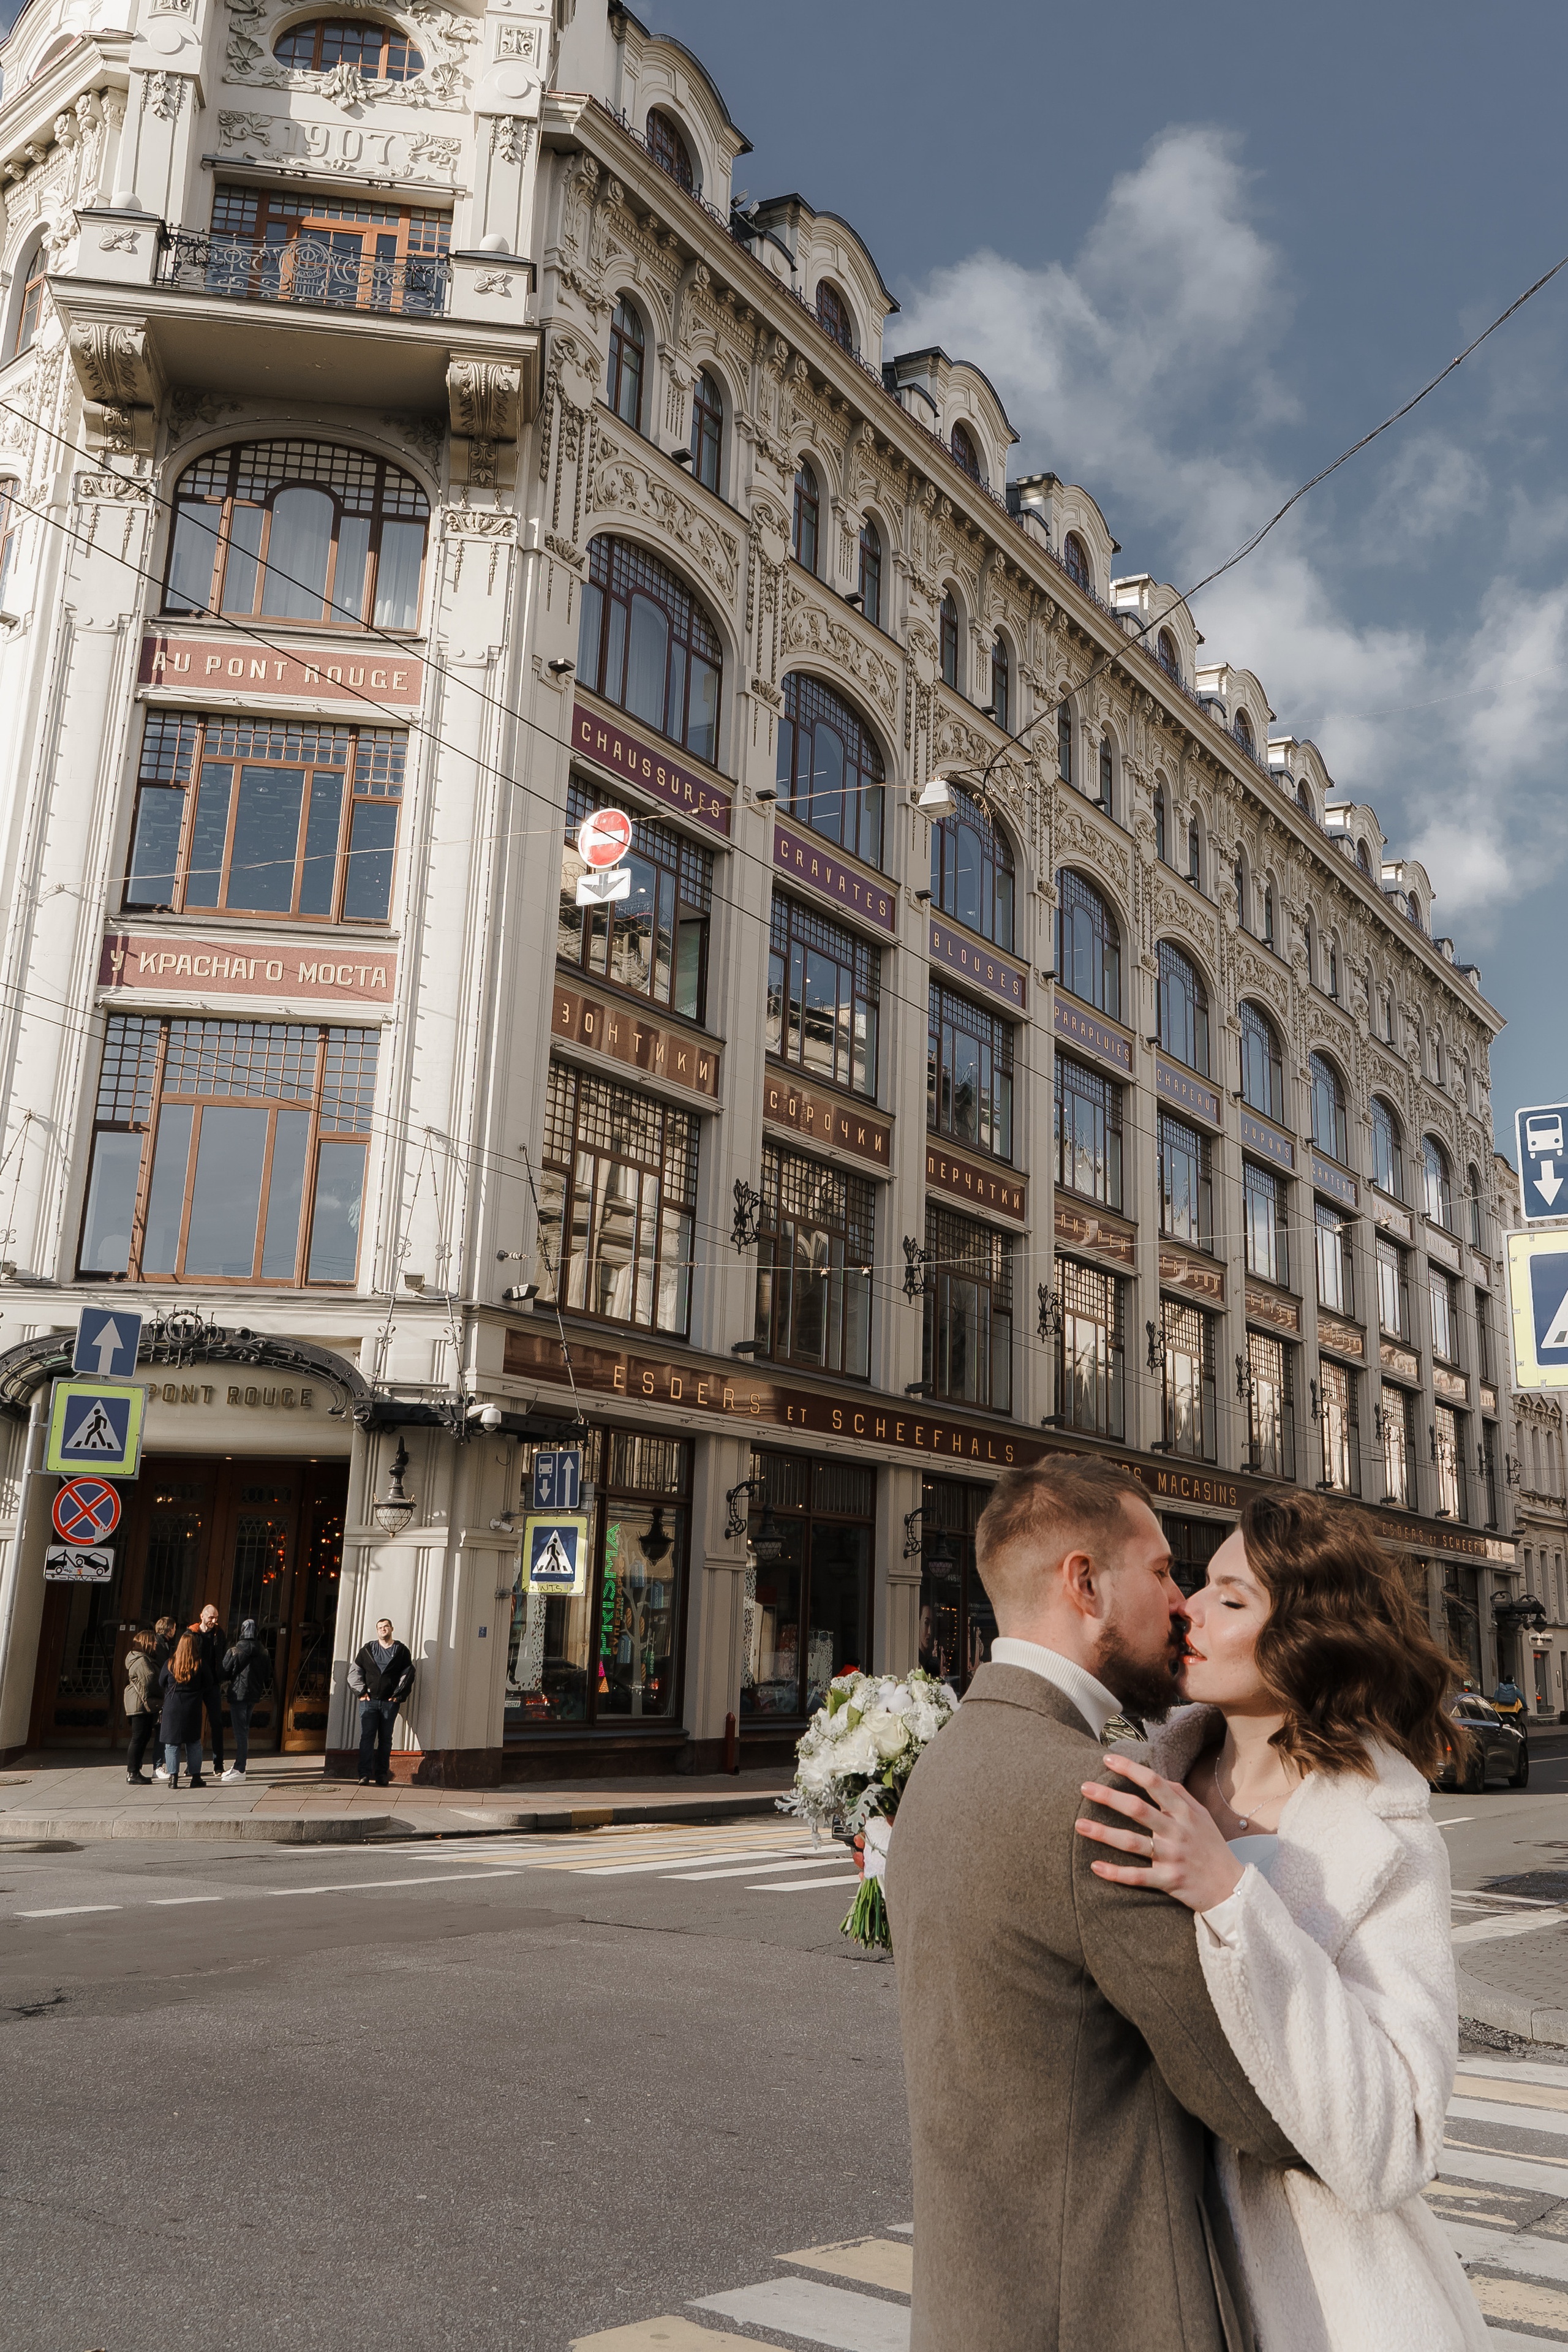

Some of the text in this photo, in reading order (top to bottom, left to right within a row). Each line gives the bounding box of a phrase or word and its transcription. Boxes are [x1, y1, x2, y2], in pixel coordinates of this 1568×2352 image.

[283, 126, 396, 165] 1907
[153, 652, 410, 692] AU PONT ROUGE
[581, 721, 722, 818] CHAUSSURES
[781, 840, 888, 918] CRAVATES
[110, 949, 388, 989] У КРАСНАГО МОСТА
[933, 932, 1020, 996] BLOUSES
[562, 1002, 709, 1081] ЗОНТИКИ
[1156, 1068, 1218, 1116] CHAPEAUX
[770, 1090, 882, 1152] СОРОЧКИ
[1243, 1125, 1290, 1160] JUPONS
[929, 1156, 1020, 1210] ПЕРЧАТКИ
[1060, 1213, 1126, 1253] ЛИВРЕИ
[1163, 1256, 1219, 1292] ГАЛОШИ
[1250, 1294, 1292, 1321] БЛУЗЫ
[1318, 1323, 1362, 1351] АЛСТУКИ
[227, 1385, 312, 1407] ROUGE
[613, 1365, 1013, 1462] ESDERS ET SCHEEFHALS
[1382, 1522, 1423, 1542] ESDERS
